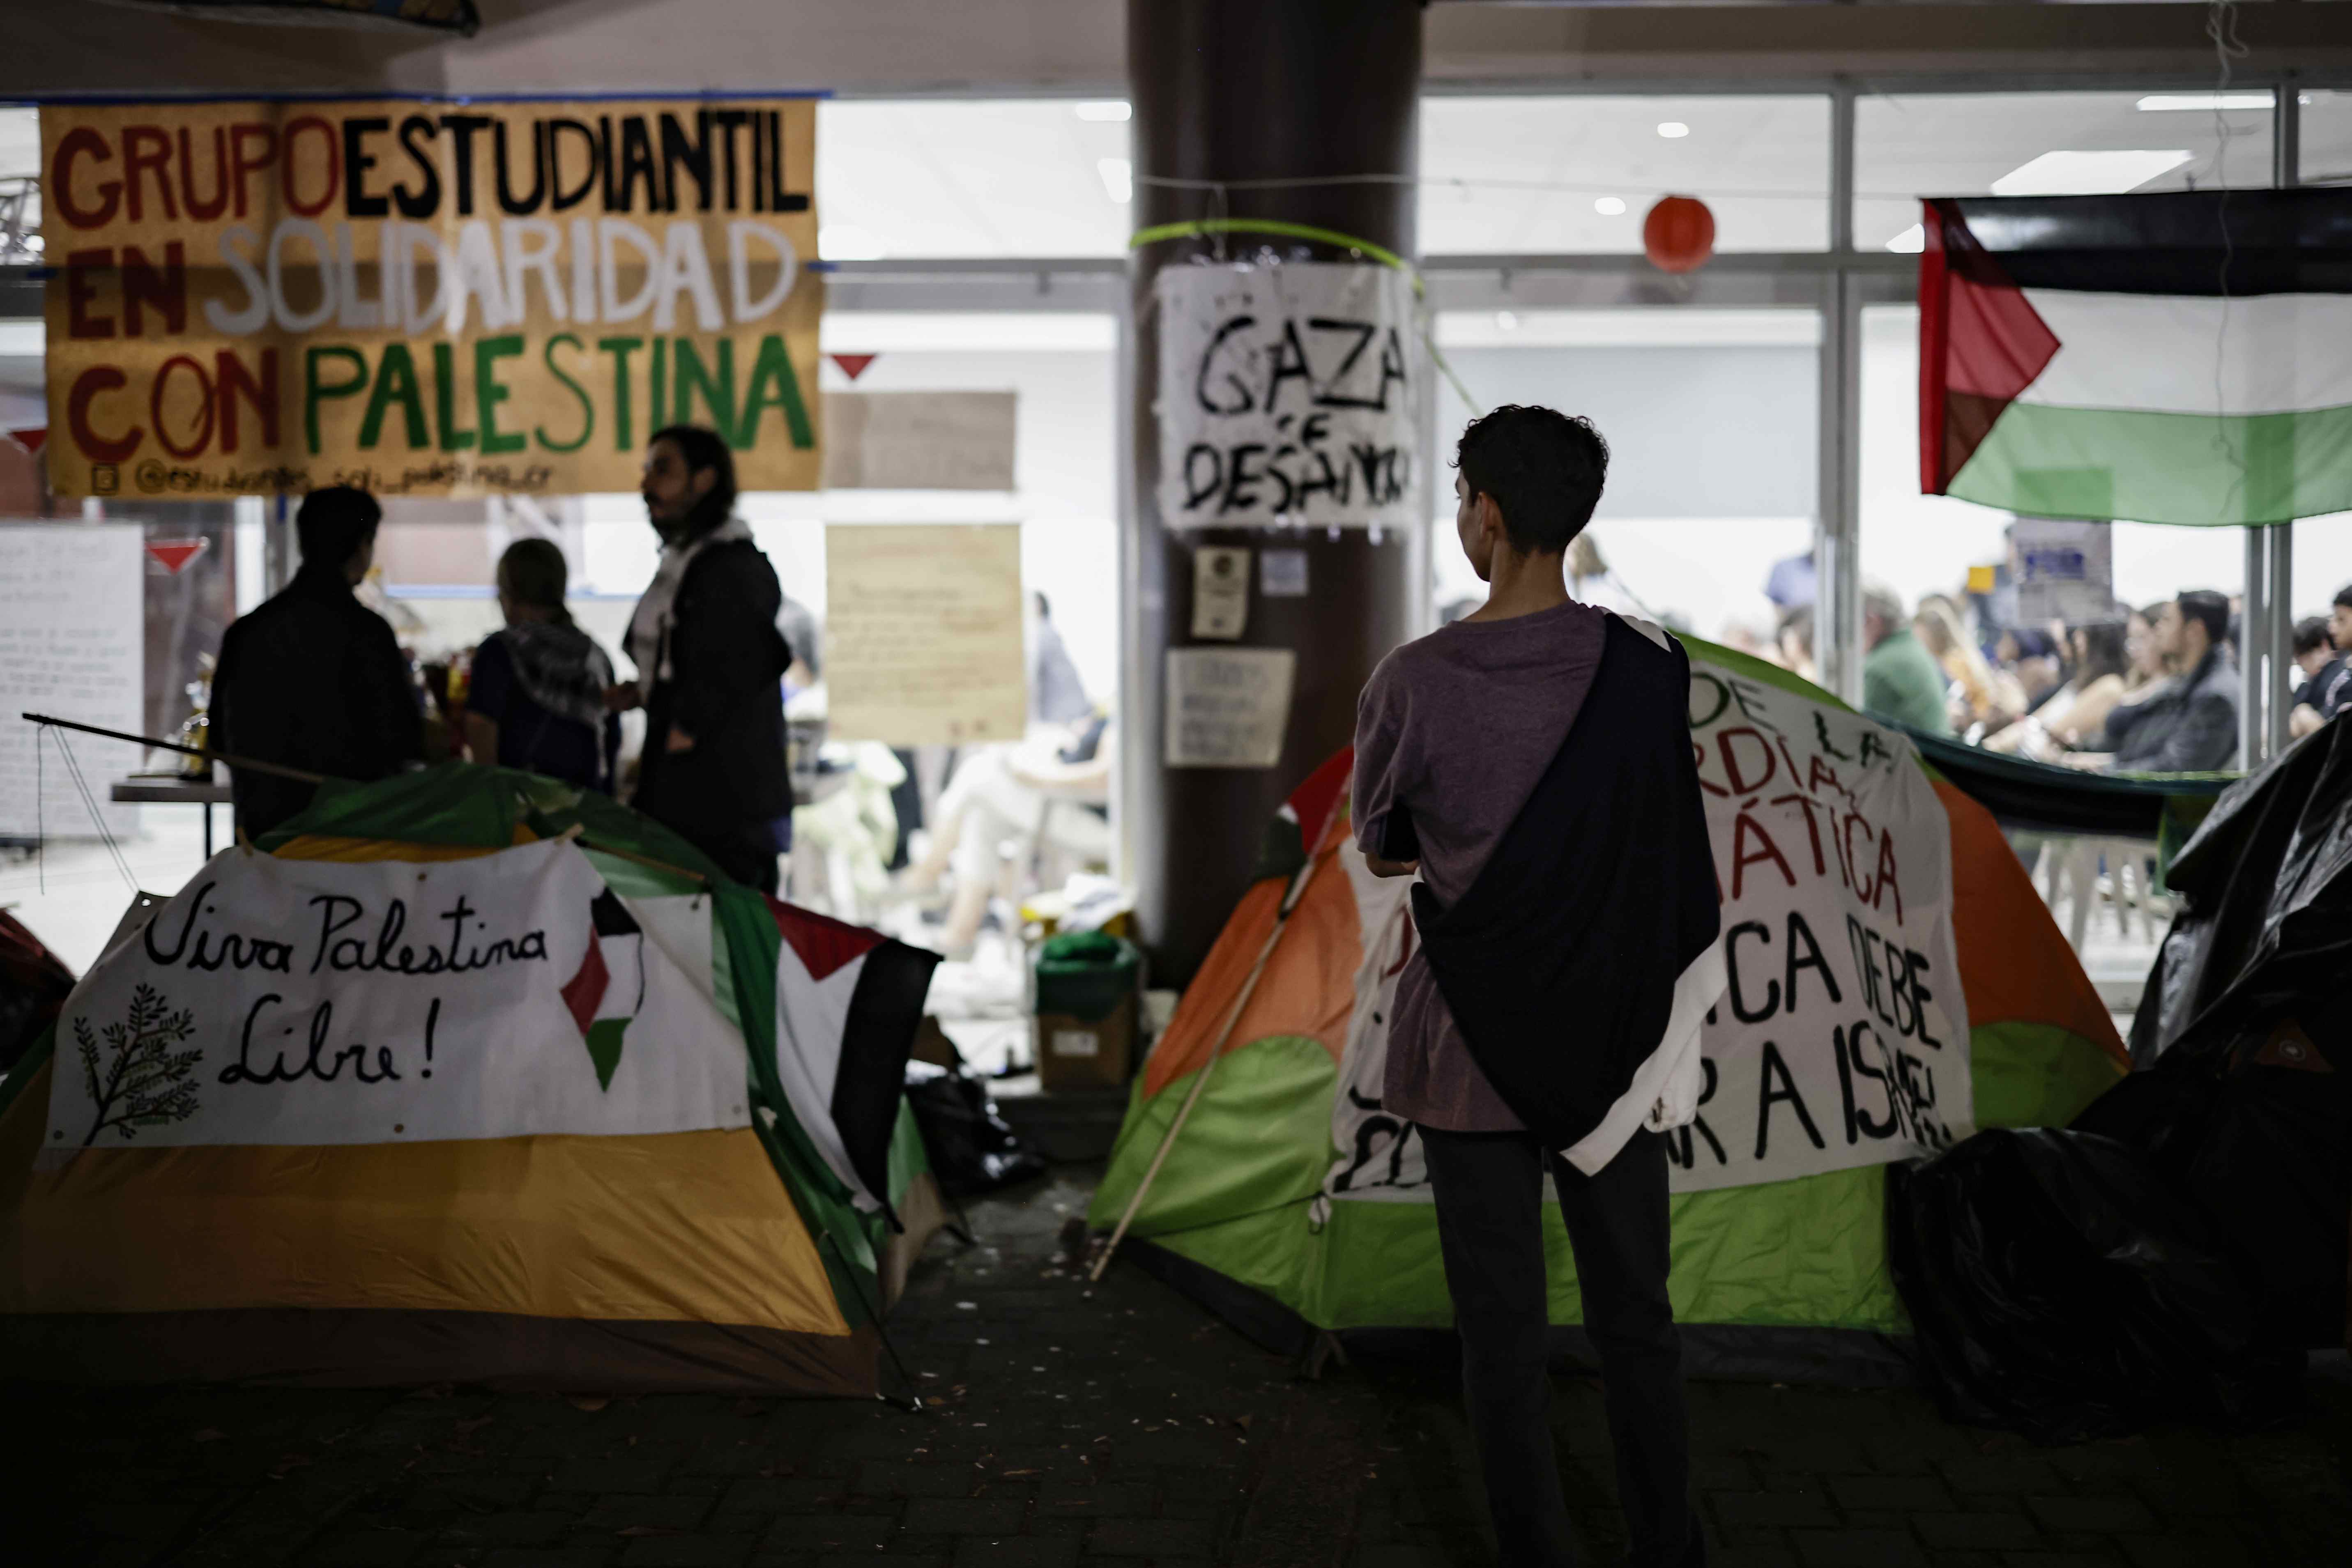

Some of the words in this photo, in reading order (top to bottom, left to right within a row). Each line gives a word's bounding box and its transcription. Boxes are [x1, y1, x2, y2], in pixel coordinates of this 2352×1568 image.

[52, 116, 339, 229] GRUPO
[343, 110, 810, 218] ESTUDIANTIL
[67, 240, 186, 340] EN
[205, 218, 798, 336] SOLIDARIDAD
[69, 347, 279, 463] CON
[304, 333, 818, 456] PALESTINA
[1196, 315, 1406, 415] GAZA
[1717, 793, 1903, 927] ÁTICA
[143, 880, 292, 973] Viva
[309, 894, 549, 976] Palestina
[1705, 910, 1843, 1026] CA
[1847, 913, 1942, 1050] DEBE
[1755, 1040, 1827, 1161] A
